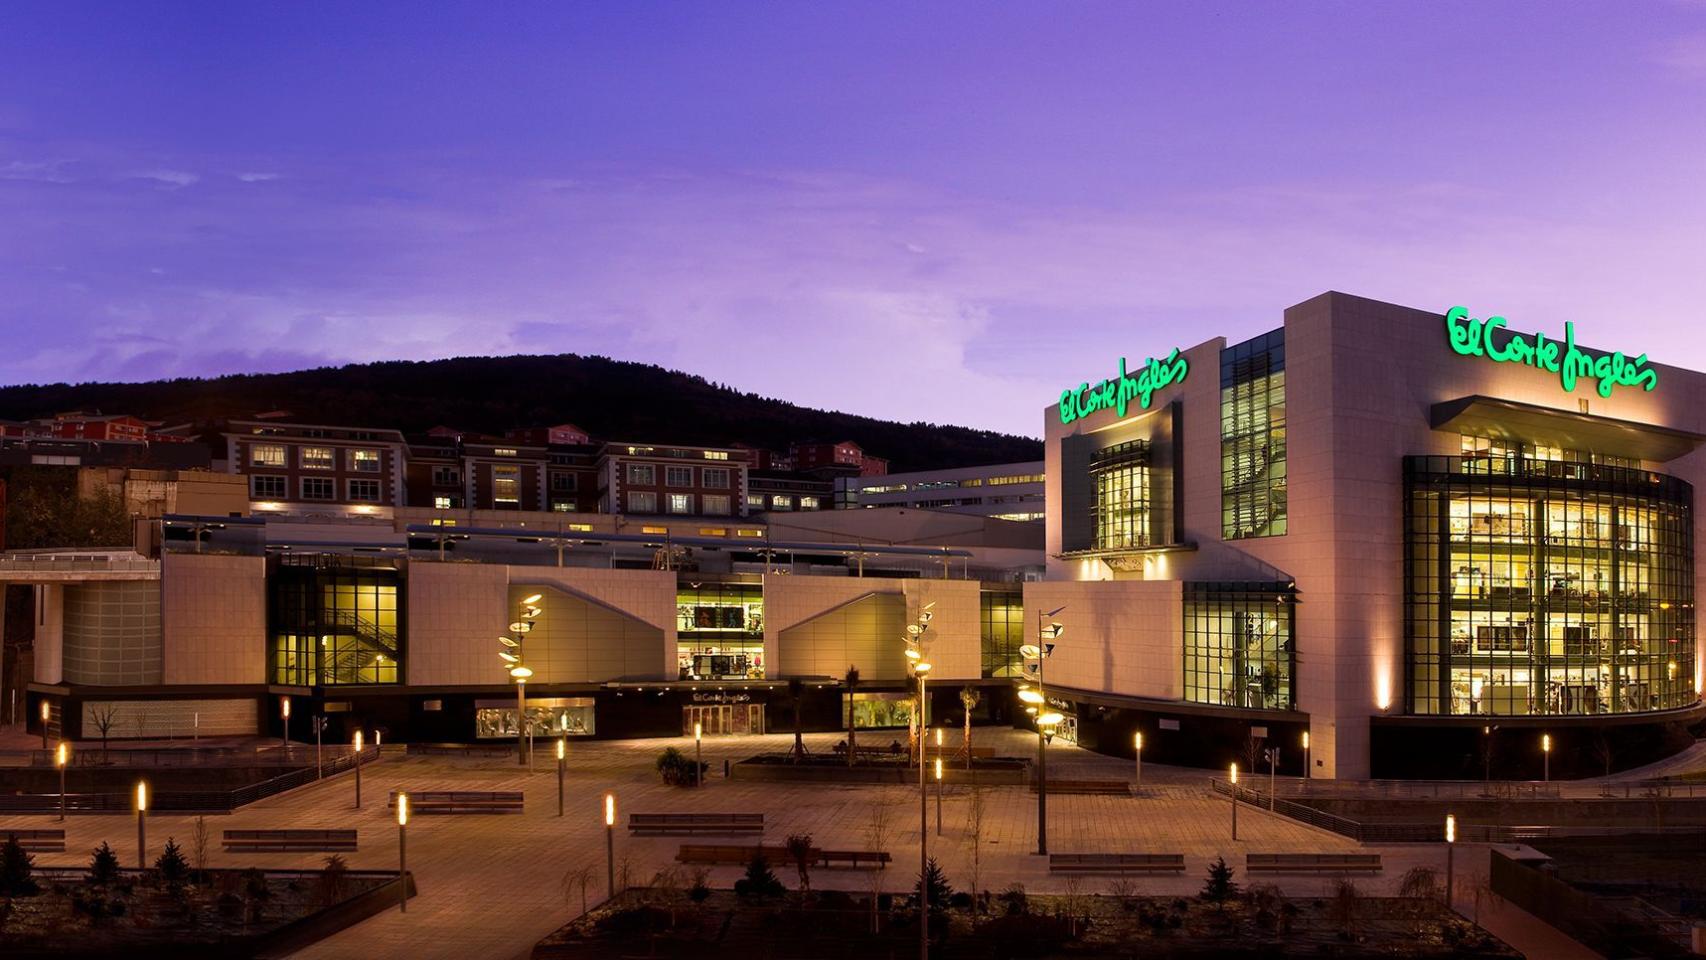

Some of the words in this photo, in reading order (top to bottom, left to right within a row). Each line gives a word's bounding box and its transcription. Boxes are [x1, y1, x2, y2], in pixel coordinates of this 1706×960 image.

[1059, 389, 1078, 425] El
[1075, 381, 1117, 419] Corte
[1116, 347, 1189, 418] Inglés
[1446, 305, 1484, 357] El
[1483, 316, 1560, 373] Corte
[1562, 321, 1658, 398] Inglés
